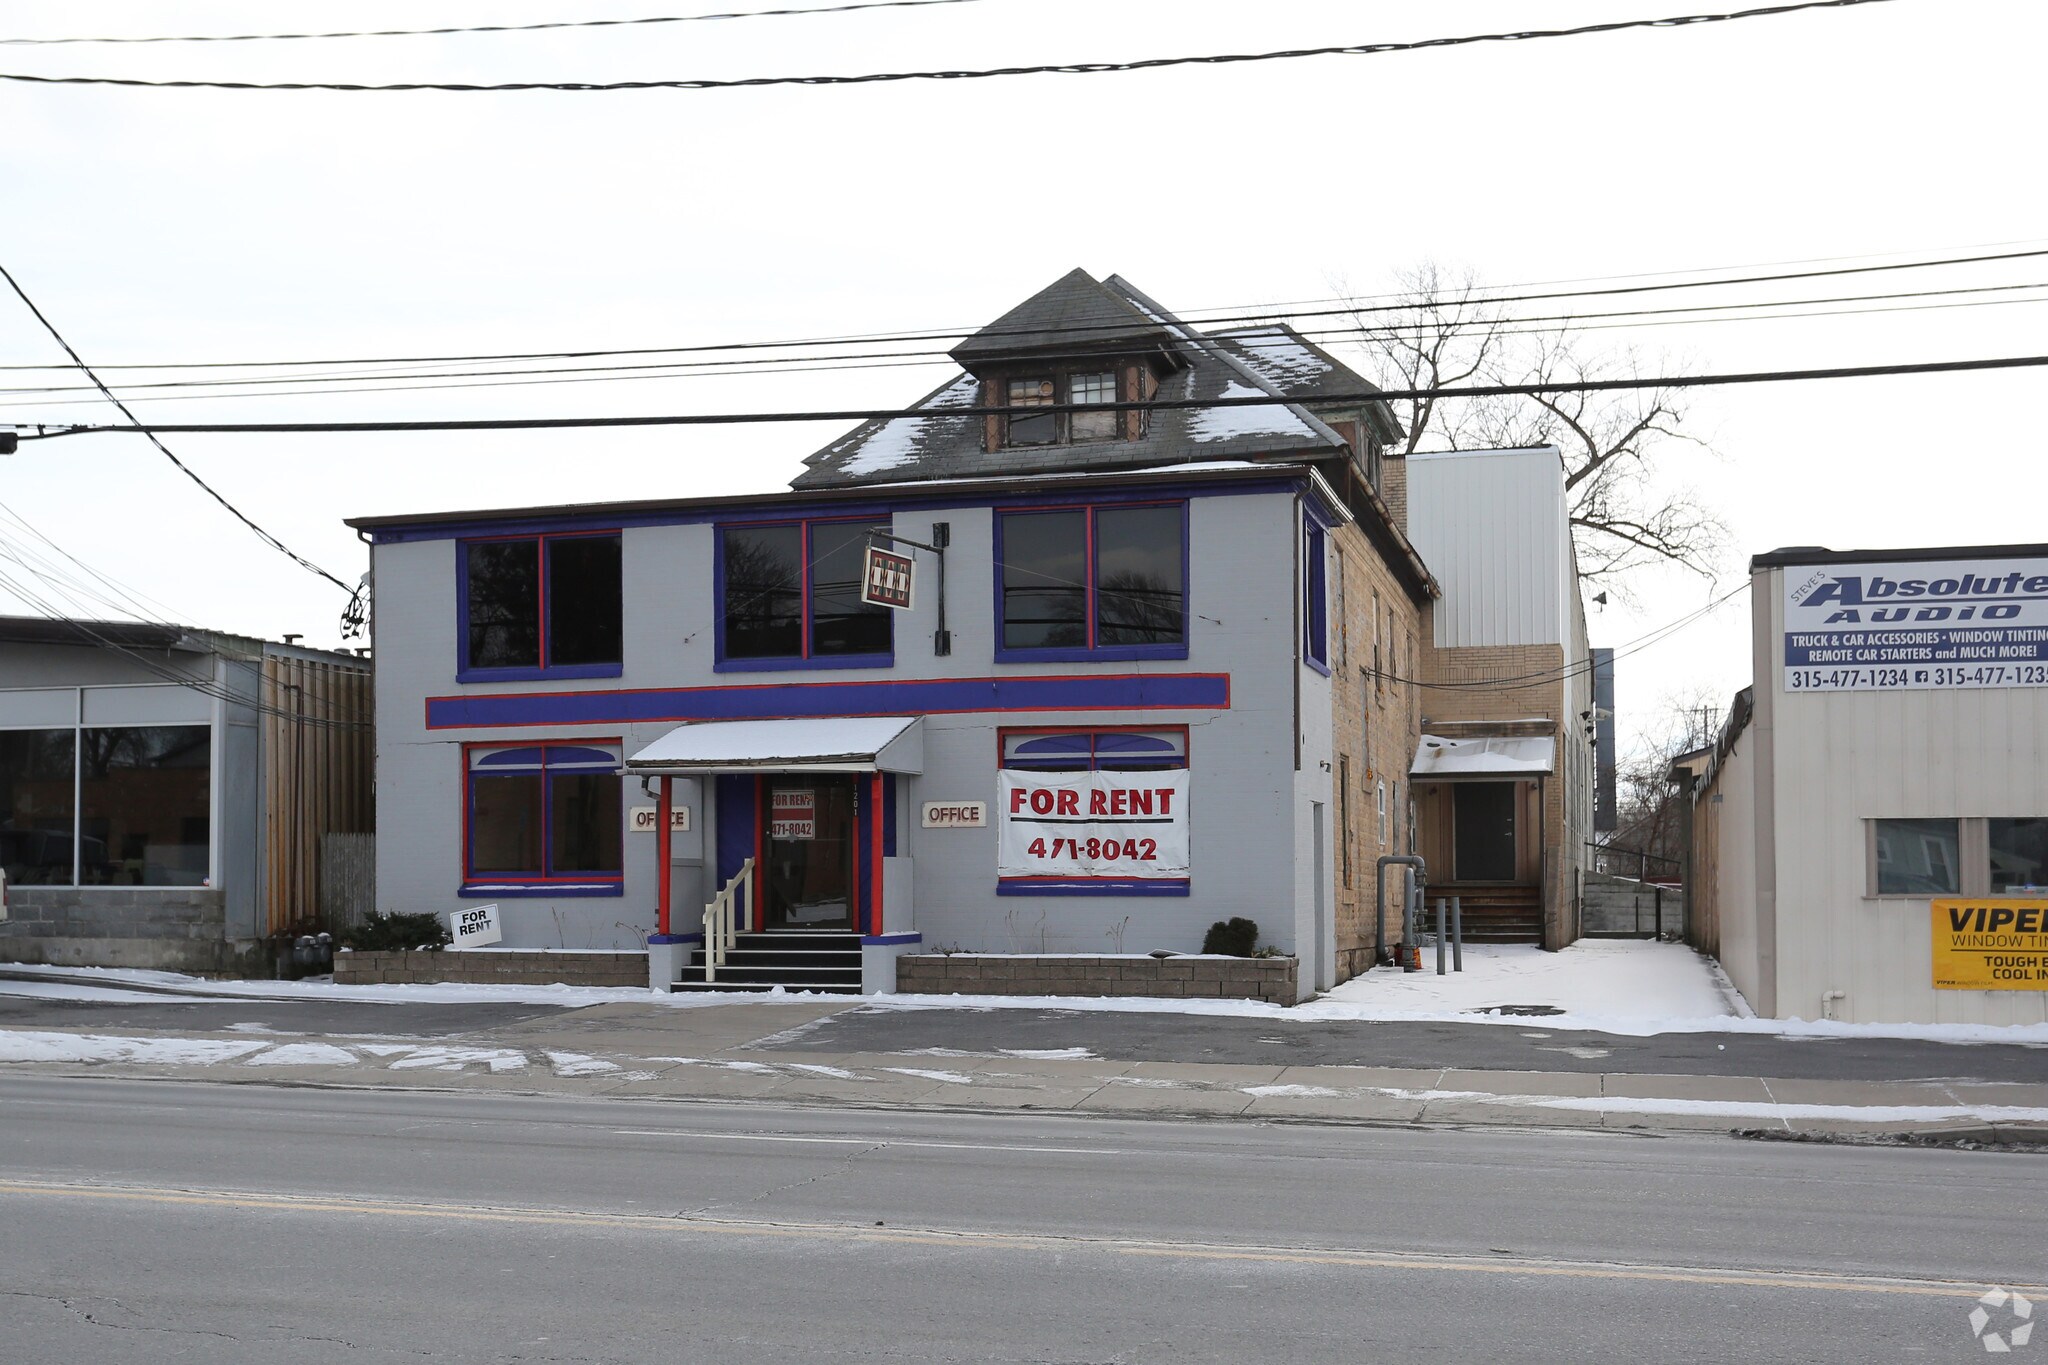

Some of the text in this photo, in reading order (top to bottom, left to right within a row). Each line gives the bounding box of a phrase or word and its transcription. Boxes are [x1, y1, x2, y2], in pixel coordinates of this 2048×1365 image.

[1791, 571, 1825, 602] STEVE'S
[1799, 572, 2048, 607] Absolute
[1823, 605, 2022, 624] AUDIO
[1792, 629, 2048, 647] TRUCK & CAR ACCESSORIES WINDOW TINTIN
[1808, 645, 2037, 662] REMOTE CAR STARTERS and MUCH MORE!
[1792, 669, 1908, 687] 315-477-1234
[1935, 666, 2048, 685] 315-477-123
[1010, 788, 1175, 816] FOR RENT
[636, 811, 684, 826] OFCE
[928, 806, 979, 822] OFFICE
[772, 823, 812, 835] 471-8042
[1027, 837, 1157, 861] 471-8042
[462, 910, 487, 923] FOR
[459, 920, 492, 936] RENT
[1951, 935, 2048, 947] WINDOW TI
[1984, 956, 2037, 967] TOUGH
[1993, 969, 2032, 979] COOL
